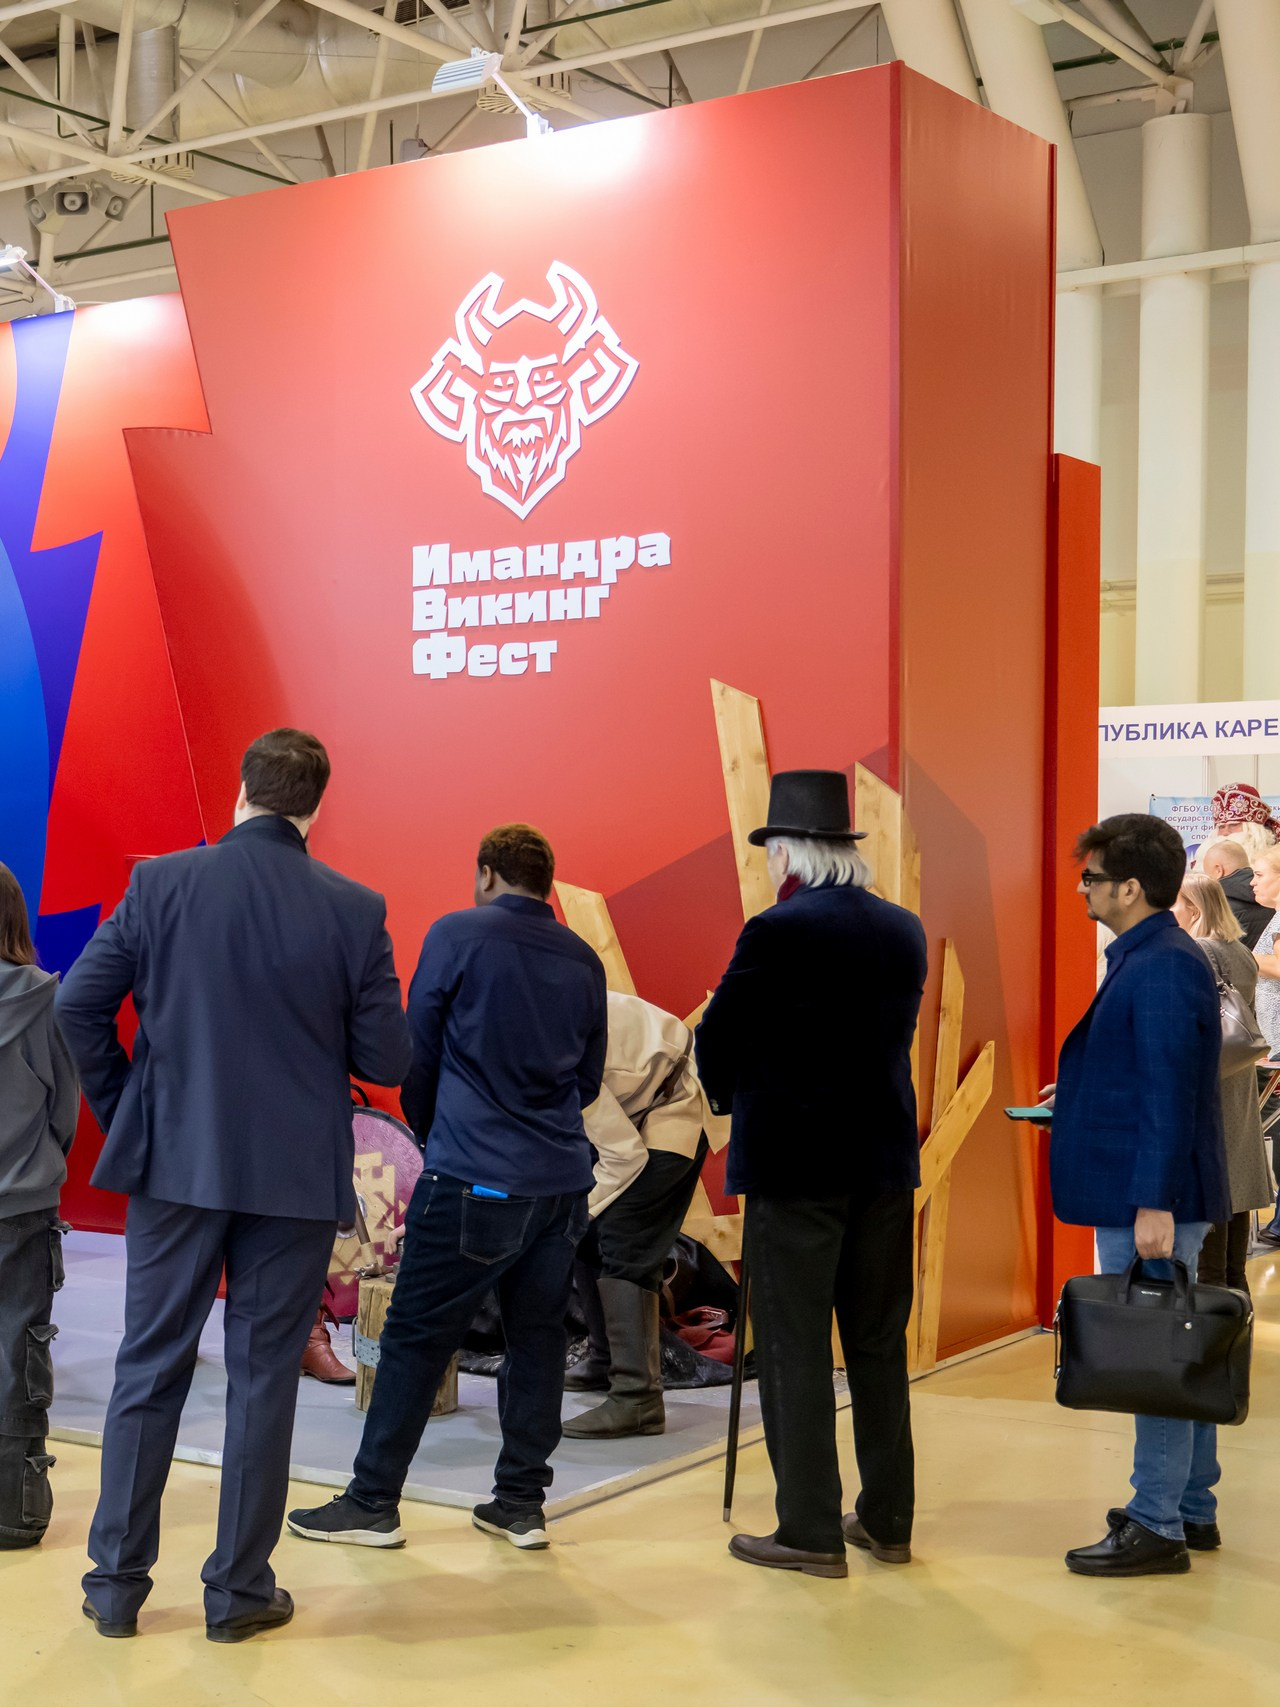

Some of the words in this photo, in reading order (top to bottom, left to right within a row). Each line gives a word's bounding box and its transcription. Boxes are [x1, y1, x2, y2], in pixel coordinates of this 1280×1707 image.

[412, 532, 671, 587] Имандра
[412, 584, 610, 631] Викинг
[412, 631, 558, 680] Фест
[1215, 718, 1279, 738] КАРЕ
[1171, 805, 1201, 813] ФГБОУ
